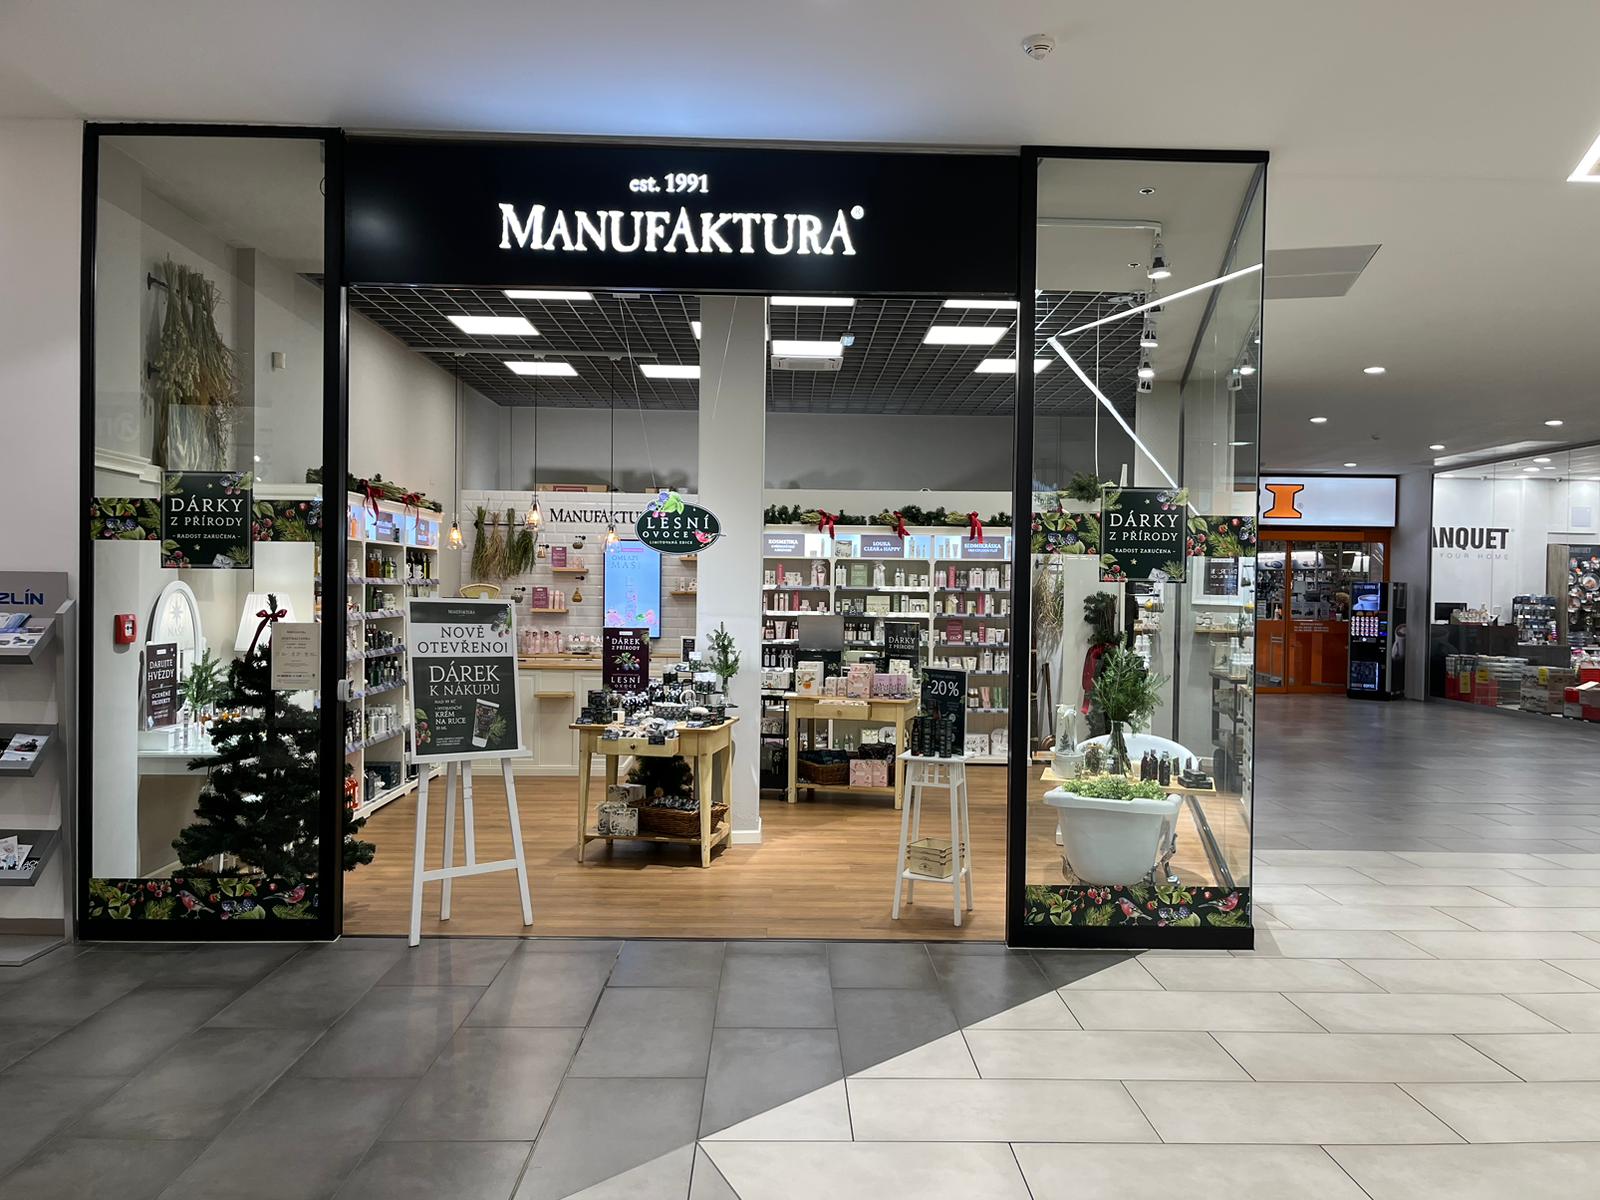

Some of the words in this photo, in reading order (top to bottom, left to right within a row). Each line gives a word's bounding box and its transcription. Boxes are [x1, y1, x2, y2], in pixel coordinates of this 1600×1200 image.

[629, 176, 661, 192] est.
[664, 172, 709, 193] 1991
[498, 202, 857, 255] MANUFAKTURA
[170, 494, 244, 512] DÁRKY
[170, 516, 178, 526] Z
[184, 514, 243, 526] PŘÍRODY
[646, 514, 709, 529] LESNÍ
[1109, 510, 1179, 528] DÁRKY
[642, 530, 689, 538] OVOCE
[1109, 531, 1117, 540] Z
[1122, 530, 1179, 541] PŘÍRODY
[0, 588, 44, 605] ZLÍN
[441, 625, 485, 638] NOVĚ
[417, 640, 508, 653] OTEVŘENO!
[611, 636, 640, 645] DÁREK
[888, 636, 916, 644] DÁRKY
[428, 660, 500, 683] DÁREK
[611, 675, 640, 684] LESNÍ
[429, 685, 439, 696] K
[443, 682, 500, 696] NÁKUPU
[927, 680, 960, 697] -20%
[435, 710, 455, 718] KRÉM
[447, 717, 467, 725] RUCE
